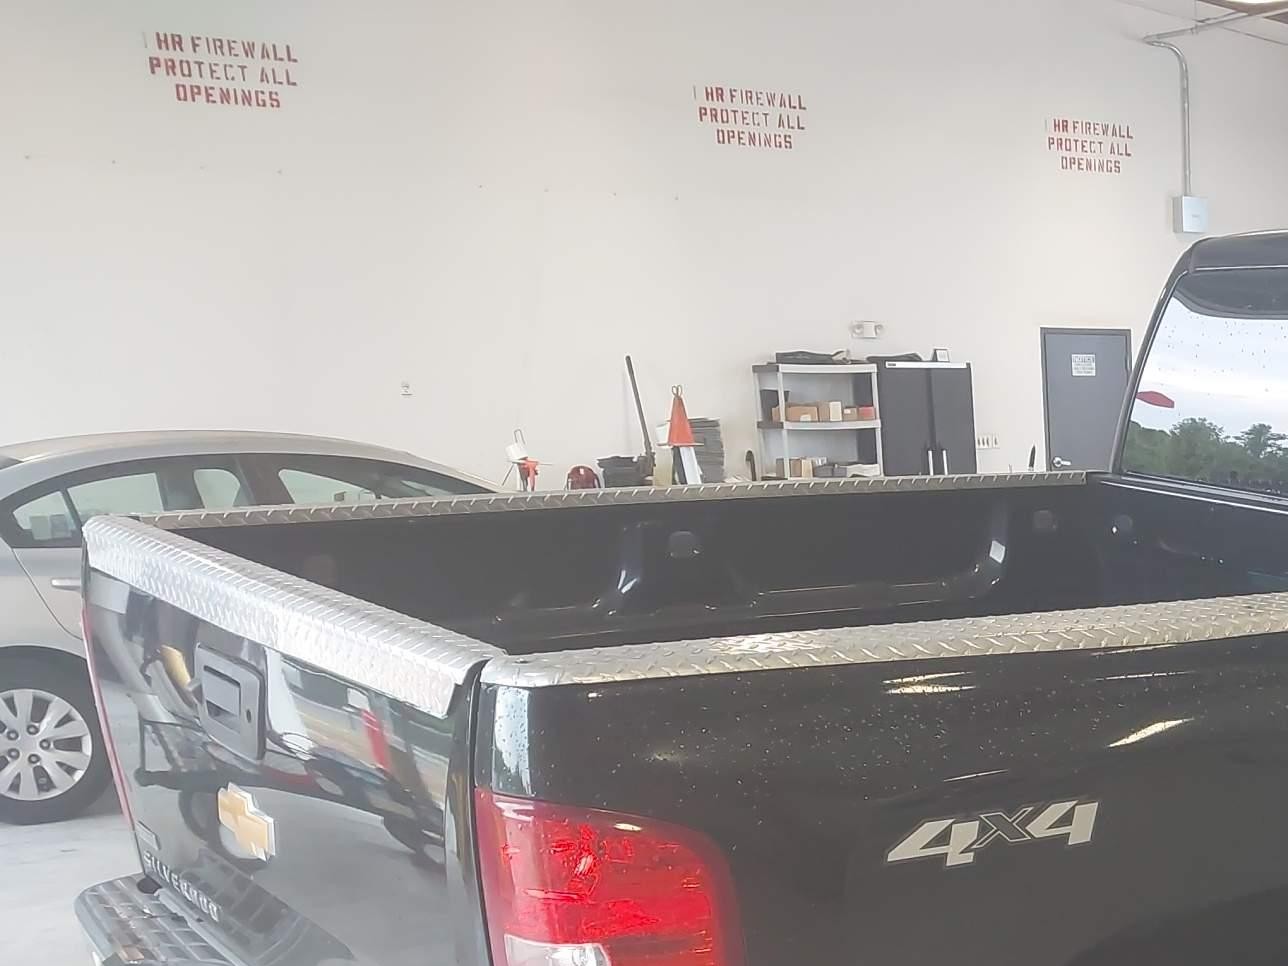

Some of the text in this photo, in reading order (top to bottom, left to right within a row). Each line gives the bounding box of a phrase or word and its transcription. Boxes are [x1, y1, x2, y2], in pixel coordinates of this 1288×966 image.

[155, 31, 185, 52] HR
[190, 35, 299, 63] FIREWALL
[148, 56, 298, 87] PROTECT ALL
[175, 83, 281, 108] OPENINGS
[705, 86, 725, 103] HR
[728, 87, 807, 111] FIREWALL
[698, 106, 806, 130] PROTECT ALL
[1053, 118, 1069, 133] HR
[1072, 120, 1134, 140] FIREWALL
[716, 128, 793, 149] OPENINGS
[1047, 136, 1132, 157] PROTECT ALL
[1061, 156, 1121, 174] OPENINGS
[143, 850, 219, 922] SILVERADO
